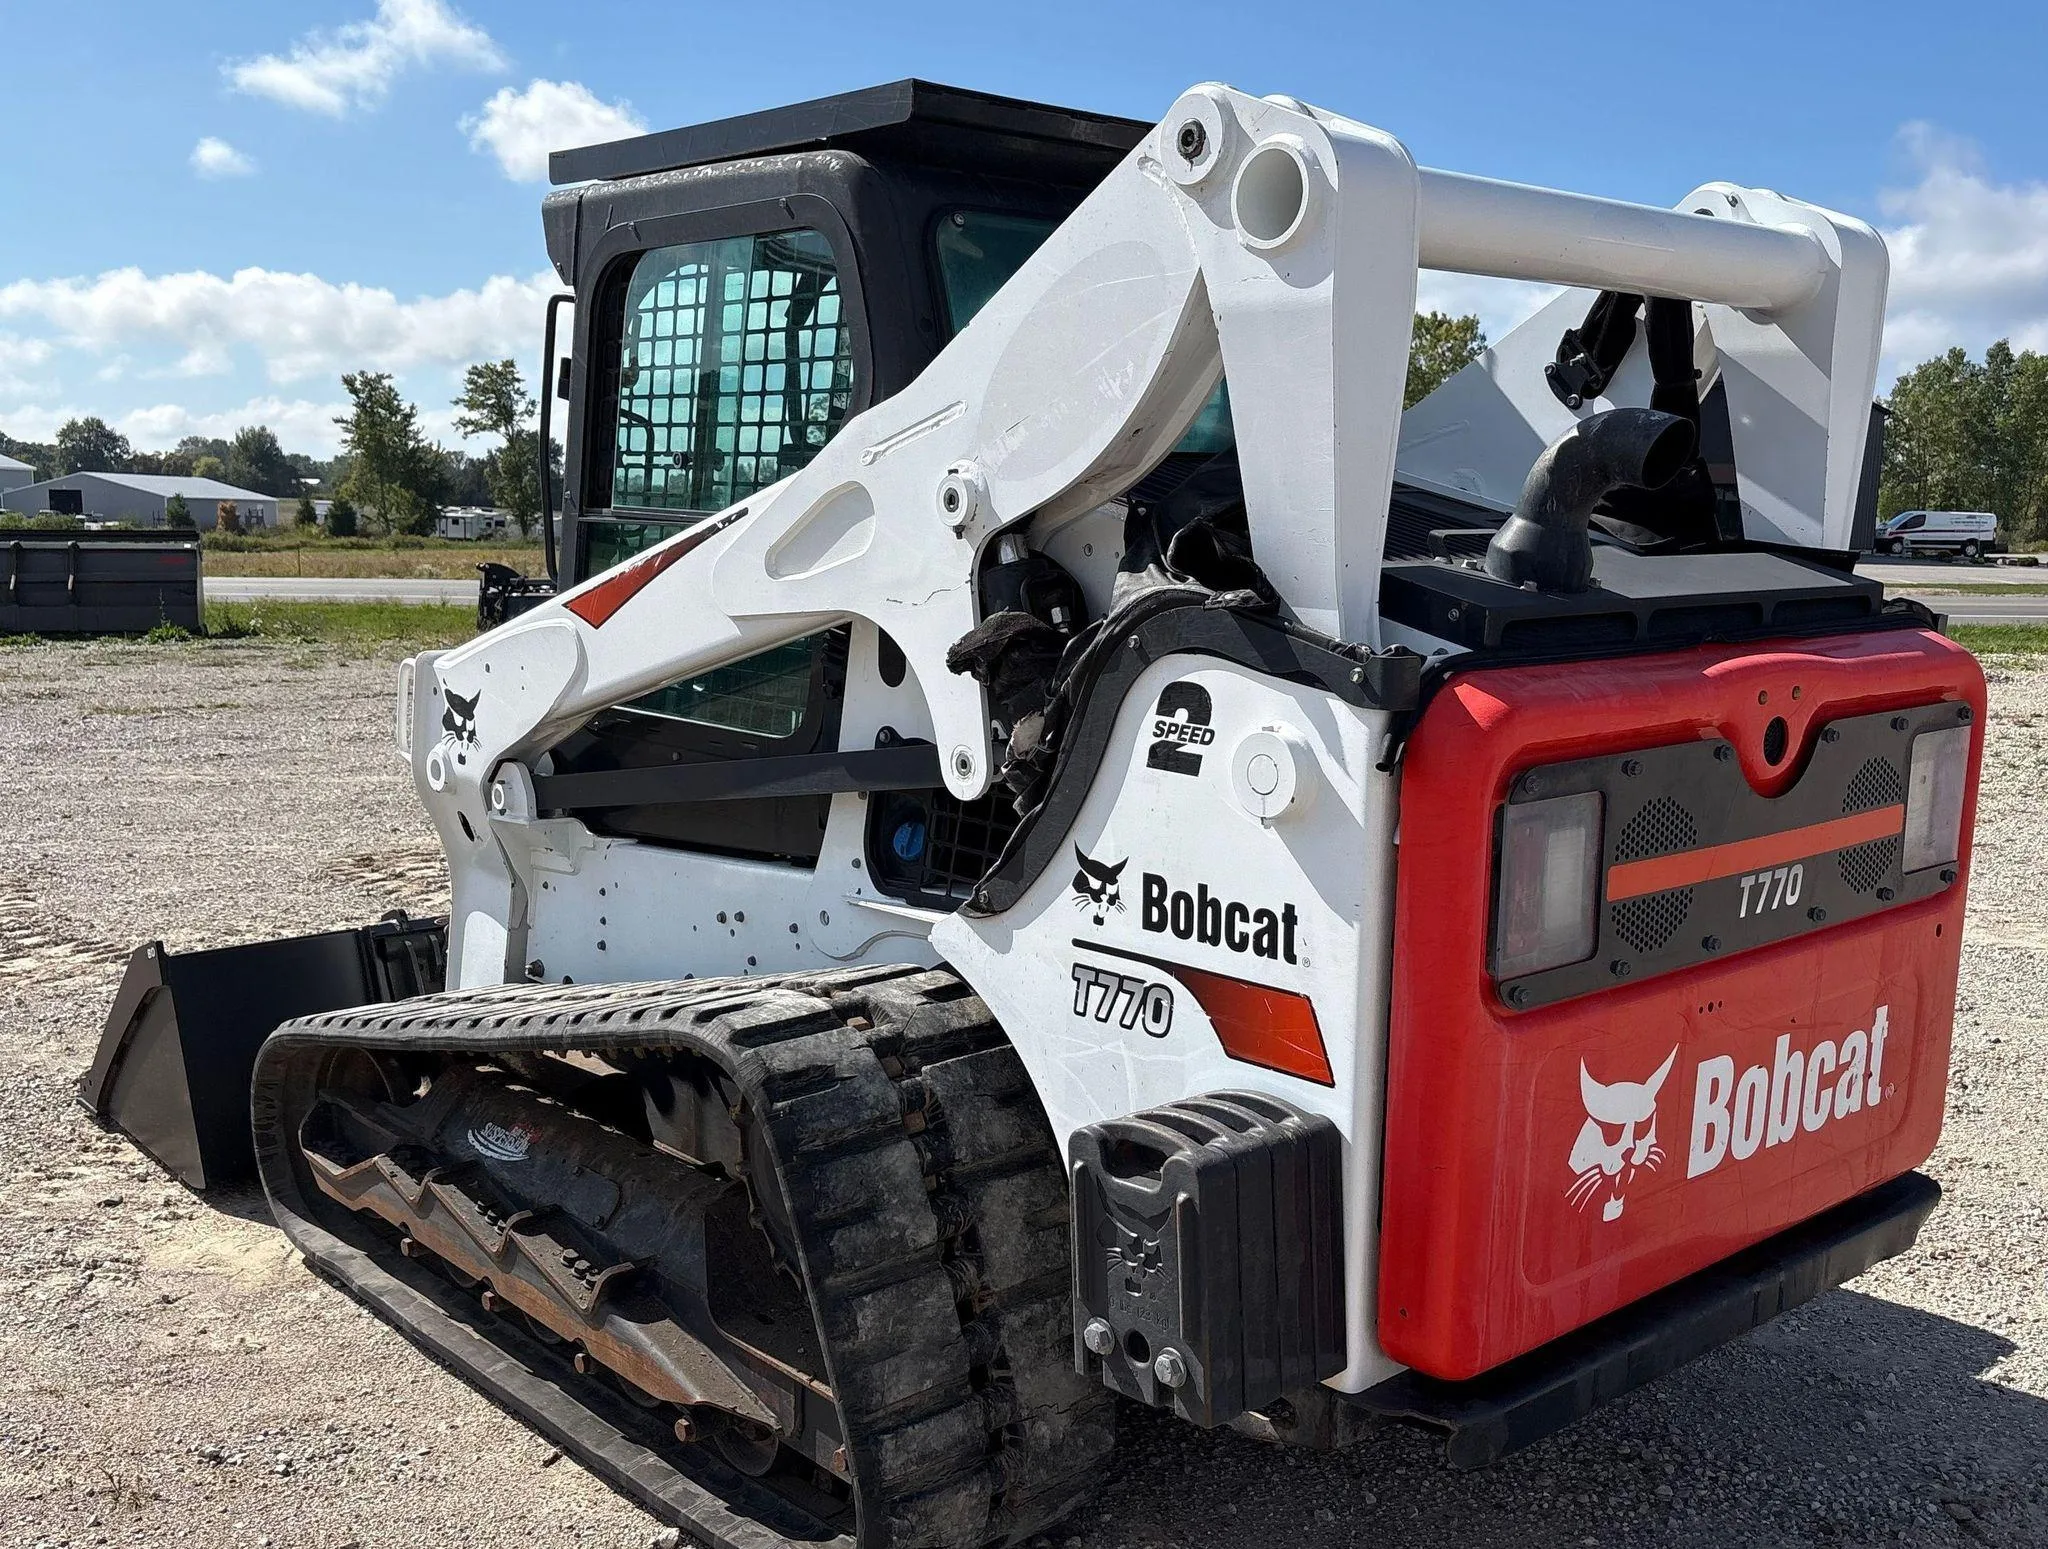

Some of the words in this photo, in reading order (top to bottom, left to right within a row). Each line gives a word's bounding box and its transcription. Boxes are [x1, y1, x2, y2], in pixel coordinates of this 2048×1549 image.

[1146, 681, 1212, 777] 2
[1152, 720, 1215, 746] SPEED
[1142, 872, 1298, 965] Bobcat
[1739, 864, 1803, 919] T770
[1072, 963, 1174, 1038] T770
[1687, 1005, 1889, 1179] Bobcat
